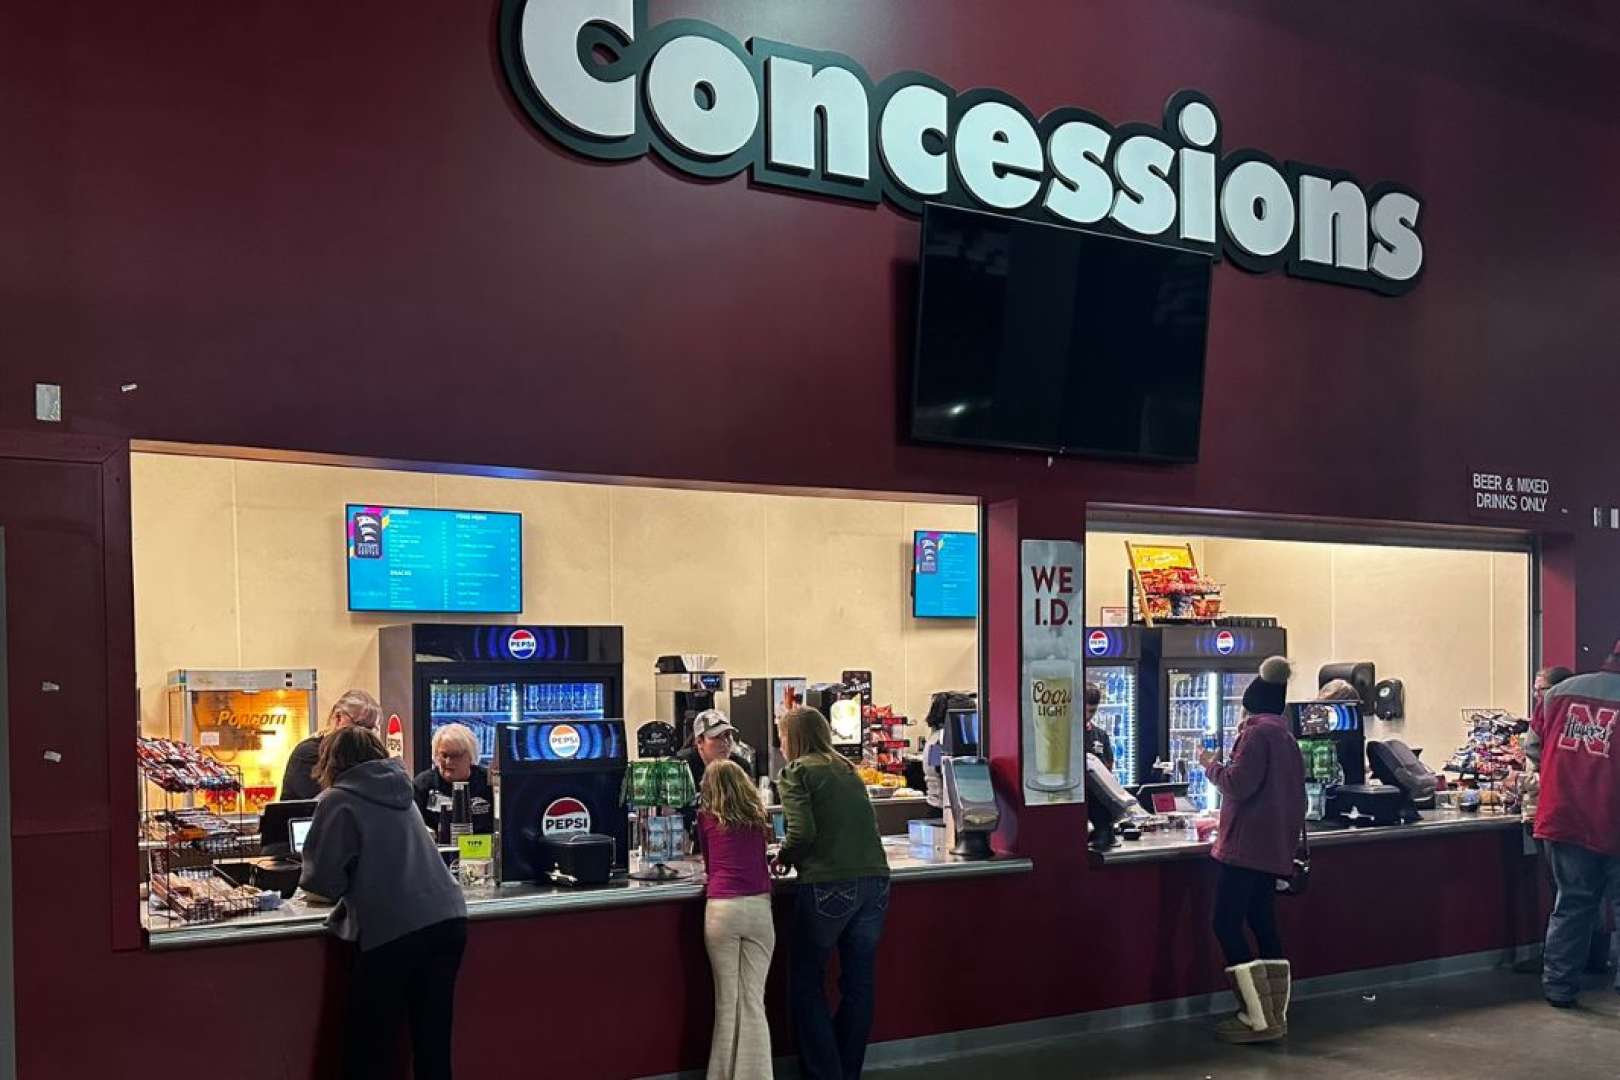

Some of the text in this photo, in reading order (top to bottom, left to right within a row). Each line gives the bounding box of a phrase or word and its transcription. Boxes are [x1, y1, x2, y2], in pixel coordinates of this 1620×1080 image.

[520, 0, 1424, 282] Concessions
[1473, 472, 1549, 494] BEER & MIXED
[1476, 492, 1547, 512] DRINKS ONLY
[1031, 565, 1073, 594] WE
[1035, 598, 1073, 626] I.D.
[217, 709, 287, 730] Popcorn
[545, 818, 588, 830] PEPSI
